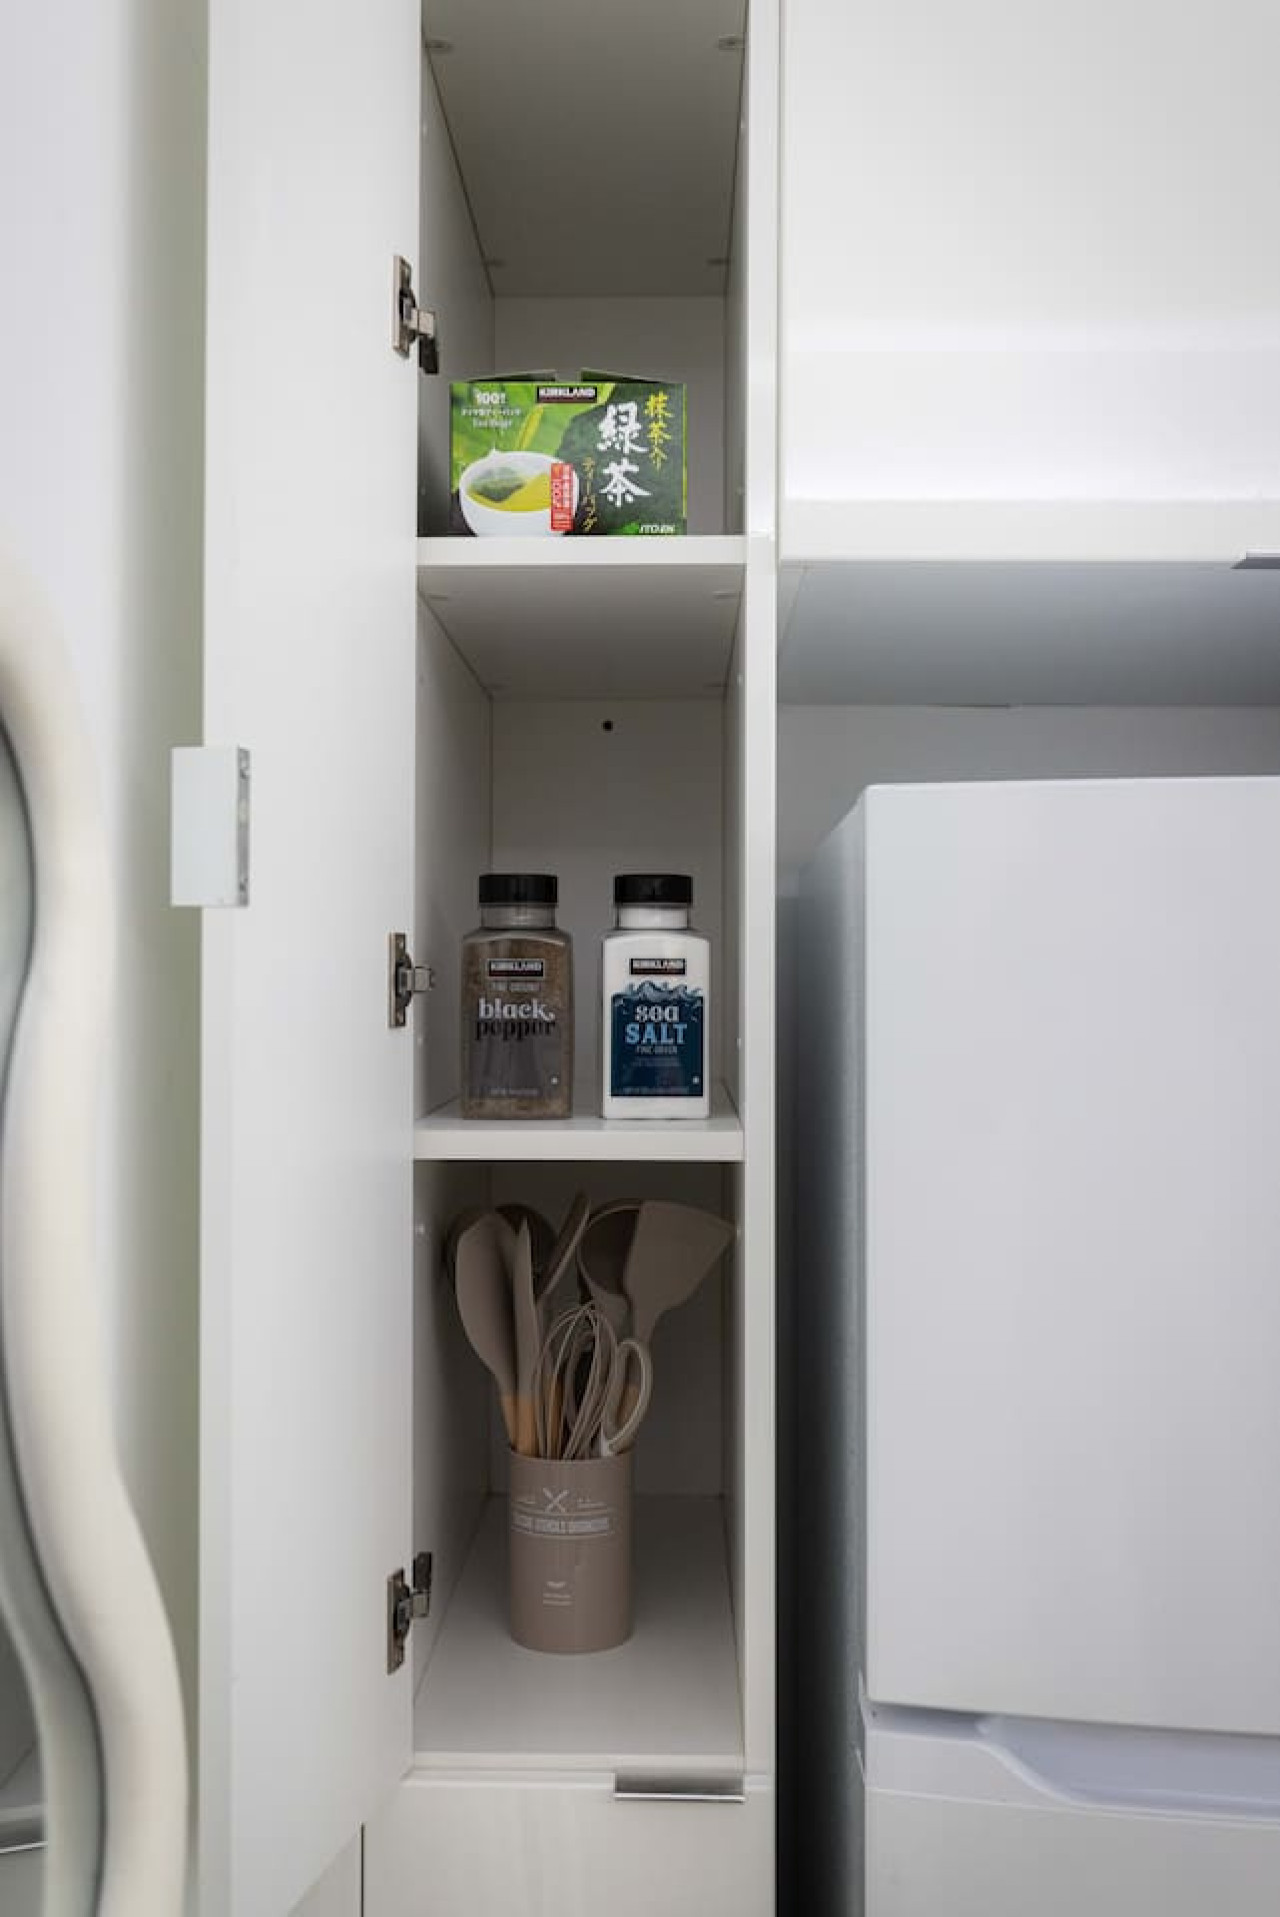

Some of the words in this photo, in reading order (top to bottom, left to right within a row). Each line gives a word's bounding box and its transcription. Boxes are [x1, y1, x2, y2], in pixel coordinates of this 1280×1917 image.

[538, 387, 596, 397] KIRKLAND
[597, 401, 651, 507] 緑茶
[490, 961, 542, 971] KIRKLAND
[632, 960, 685, 969] KIRKLAND
[479, 998, 556, 1022] black
[635, 1005, 680, 1022] sea
[475, 1021, 556, 1041] pepper
[624, 1023, 688, 1045] SALT
